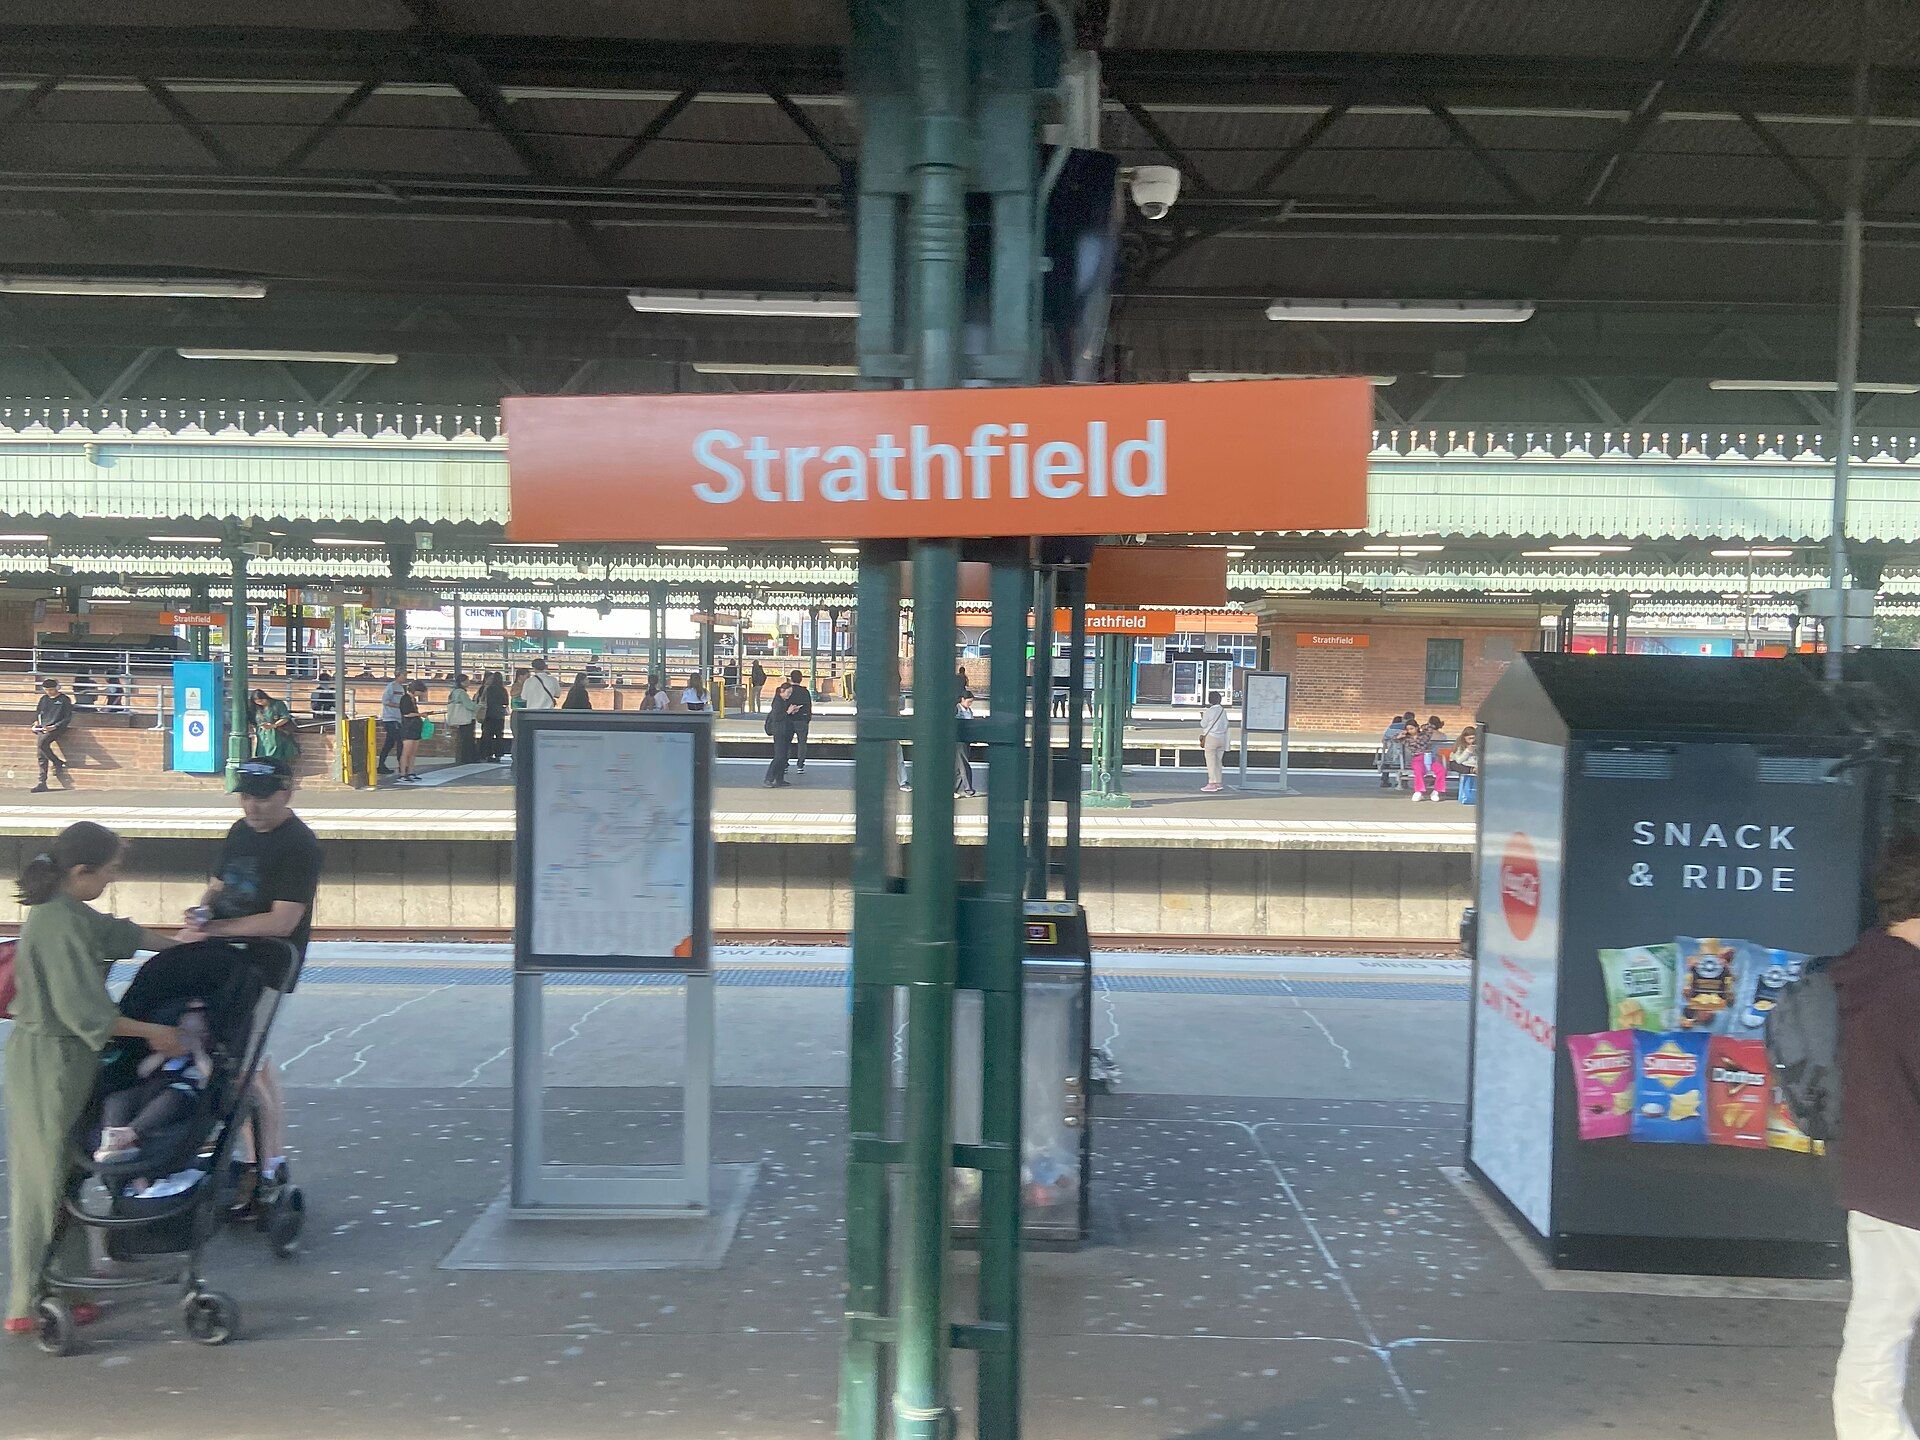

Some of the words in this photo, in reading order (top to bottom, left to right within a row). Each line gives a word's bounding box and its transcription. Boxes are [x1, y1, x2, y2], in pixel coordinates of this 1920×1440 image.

[691, 419, 1169, 505] Strathfield
[173, 615, 211, 623] Strathfield
[1085, 615, 1147, 628] rathfield
[1312, 636, 1354, 645] Strathfield
[1632, 820, 1796, 850] SNACK
[1627, 861, 1654, 887] &
[1682, 864, 1796, 892] RIDE
[760, 949, 817, 957] LINE
